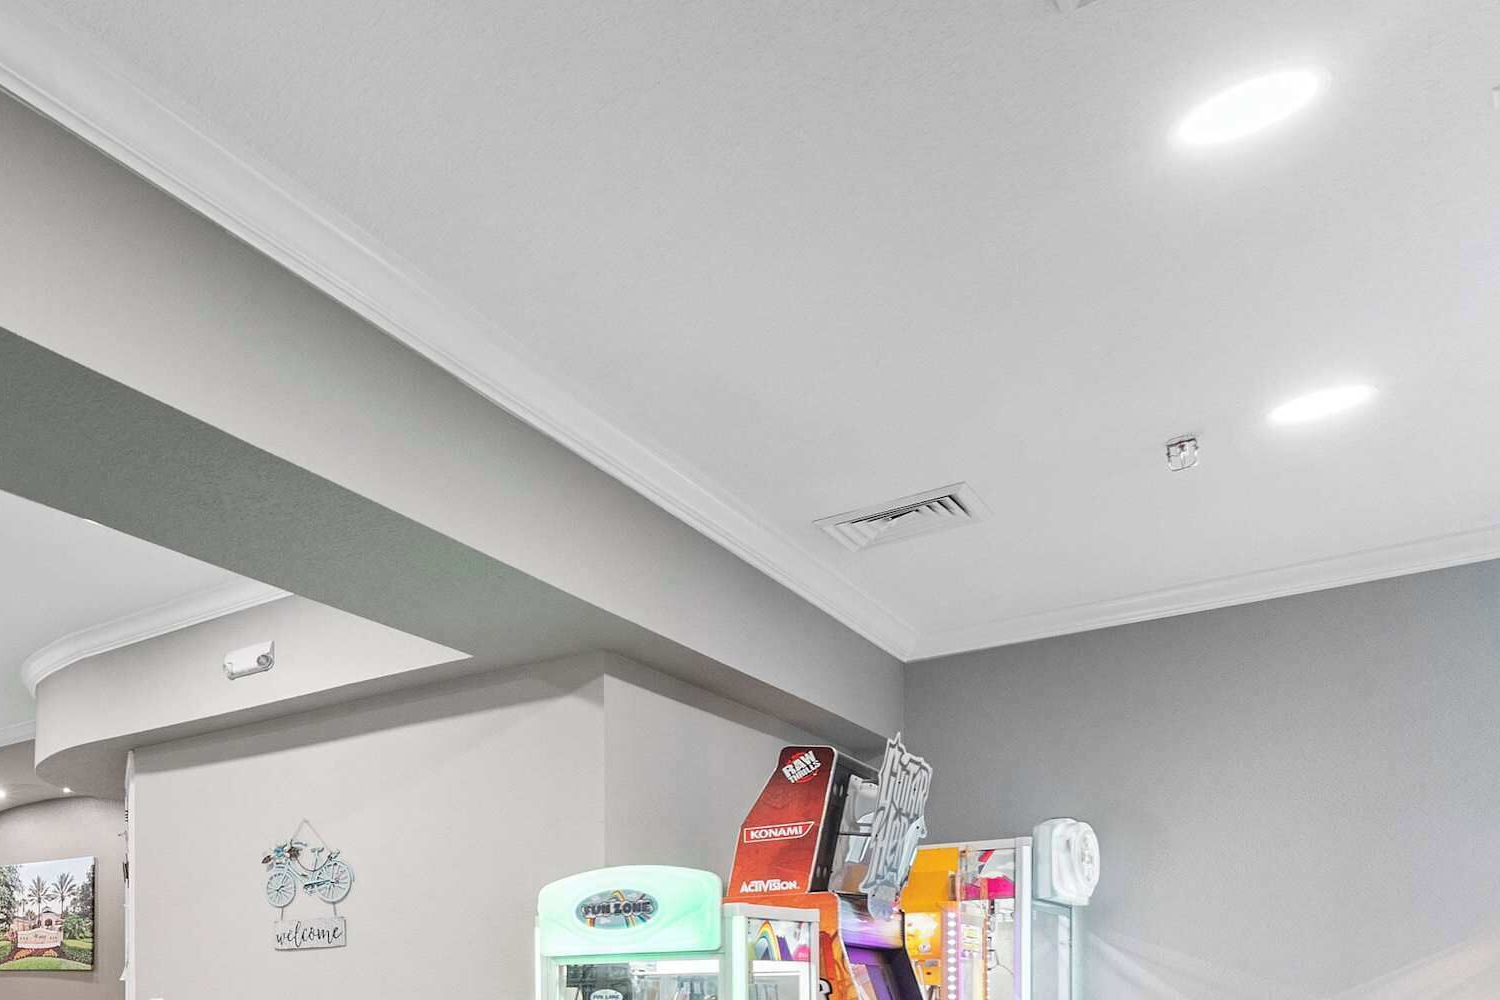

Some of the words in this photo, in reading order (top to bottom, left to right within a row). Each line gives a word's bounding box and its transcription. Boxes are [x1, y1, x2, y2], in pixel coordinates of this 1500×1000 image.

[782, 750, 816, 778] RAW
[787, 759, 822, 784] THRILLS
[750, 826, 804, 840] KONAMI
[583, 903, 611, 915] FUN
[613, 901, 652, 914] ZONE
[276, 920, 343, 947] welcome
